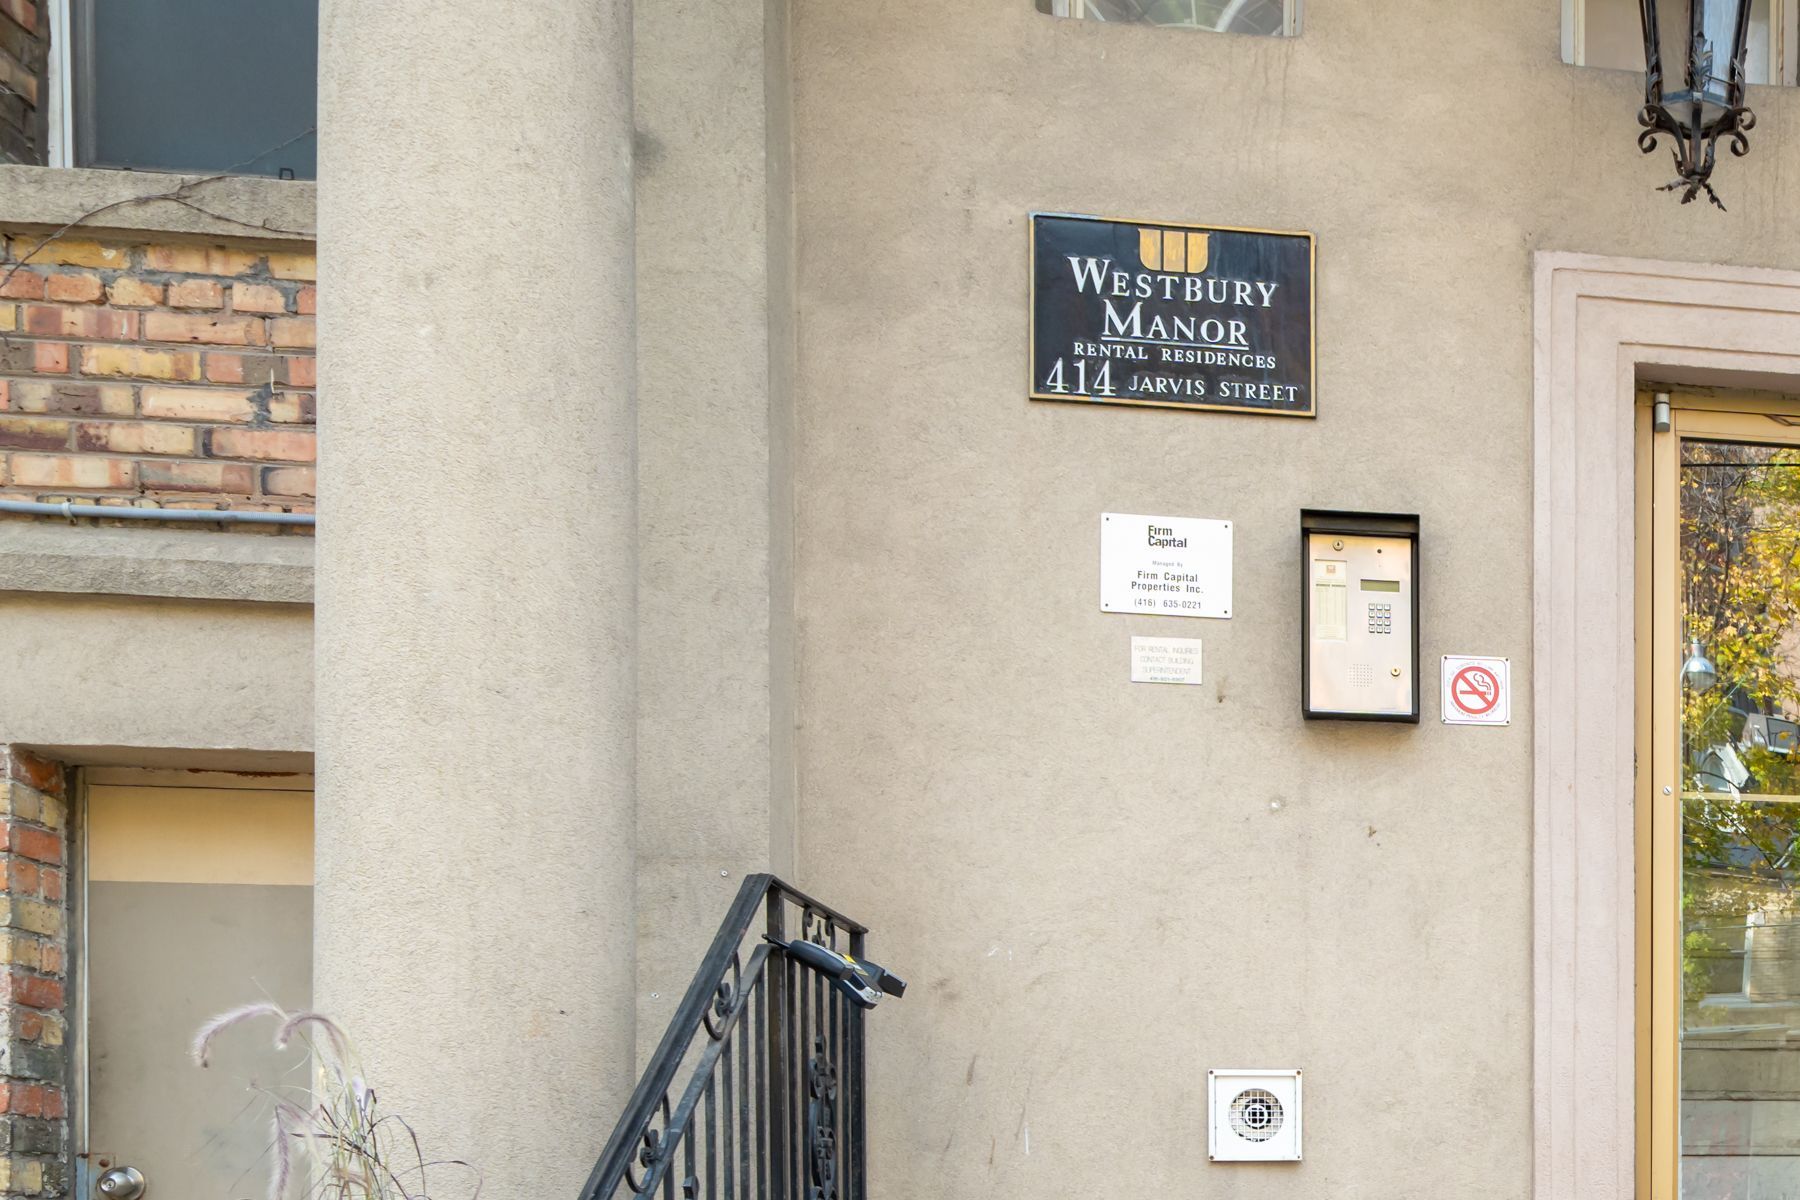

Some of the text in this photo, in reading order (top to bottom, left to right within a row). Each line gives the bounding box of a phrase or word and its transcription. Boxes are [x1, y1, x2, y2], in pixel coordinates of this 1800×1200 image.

[1067, 256, 1279, 308] WESTBURY
[1101, 299, 1250, 346] MANOR
[1074, 342, 1277, 369] RENTAL RESIDENCES
[1046, 357, 1298, 402] 414 JARVIS STREET
[1148, 525, 1173, 537] Firm
[1148, 535, 1188, 549] Capital
[1137, 570, 1198, 583] Firm Capital
[1131, 581, 1204, 594] Properties Inc.
[1134, 597, 1201, 609] (416) 635-0221
